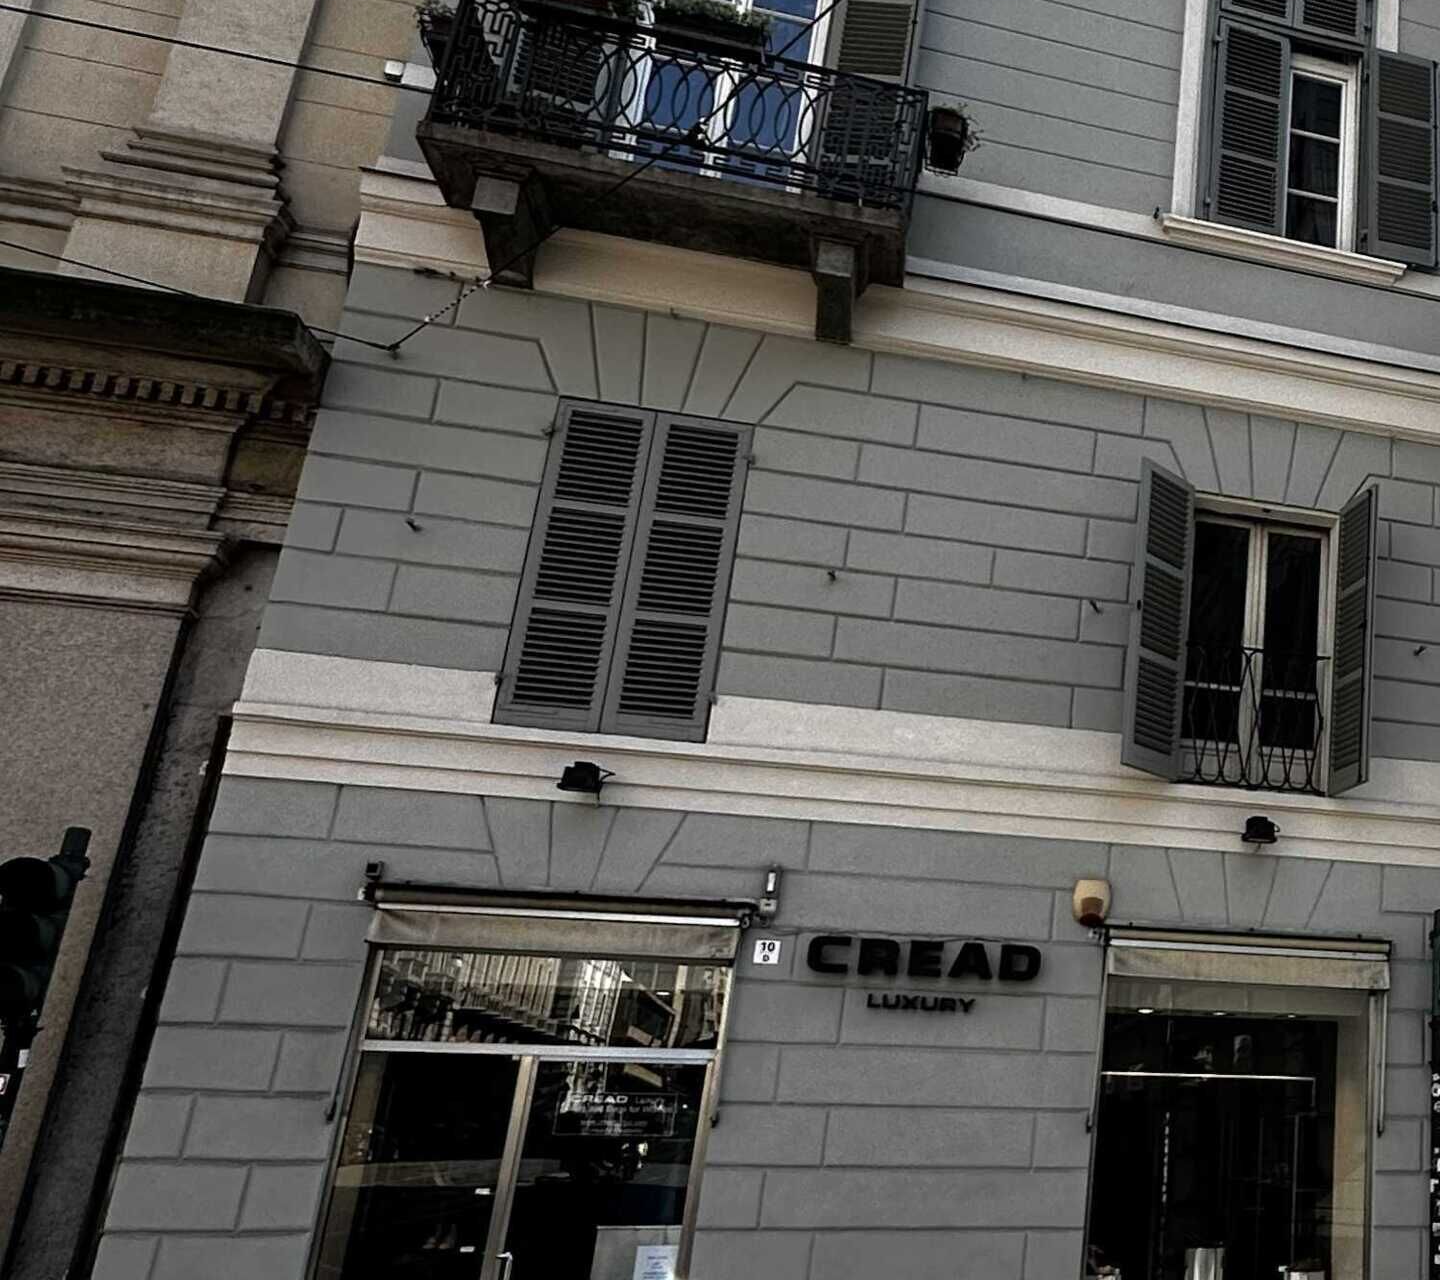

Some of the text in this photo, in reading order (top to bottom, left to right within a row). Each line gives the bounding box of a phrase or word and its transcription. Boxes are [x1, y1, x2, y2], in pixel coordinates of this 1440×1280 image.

[761, 942, 775, 952] 10
[807, 935, 1042, 981] CREAD
[866, 993, 976, 1013] LUXURY
